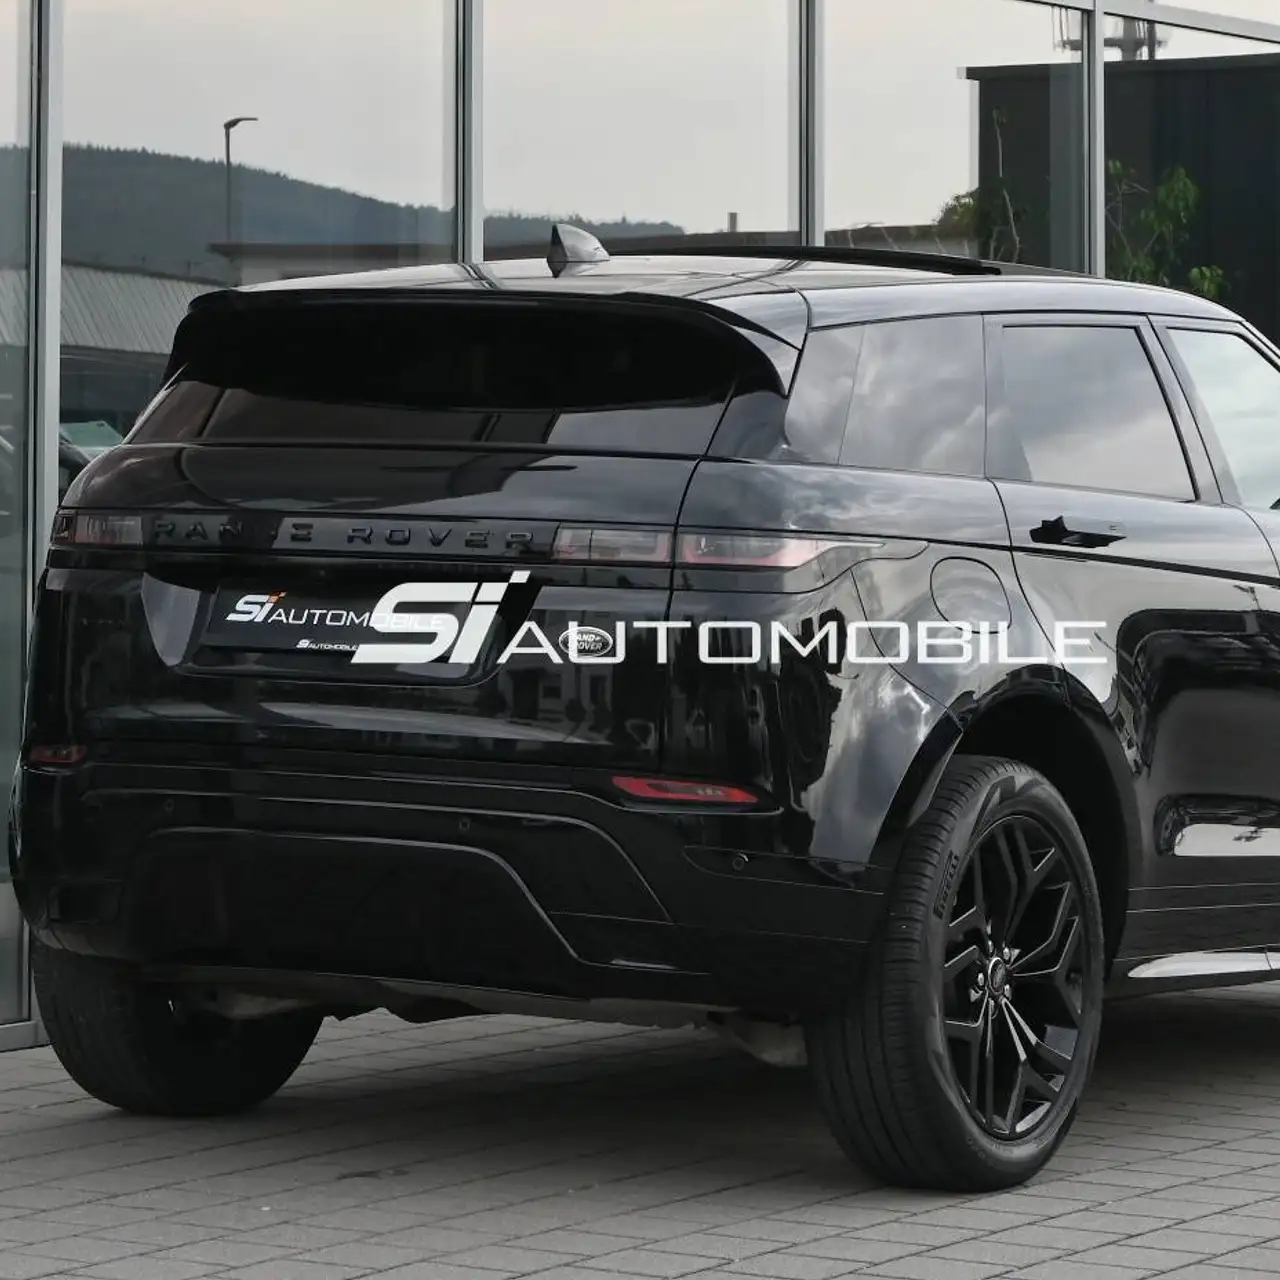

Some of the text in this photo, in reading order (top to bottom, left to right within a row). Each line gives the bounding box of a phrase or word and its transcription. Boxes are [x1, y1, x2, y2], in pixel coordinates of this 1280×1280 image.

[154, 521, 534, 550] RANE ROVER
[226, 591, 287, 622] Si
